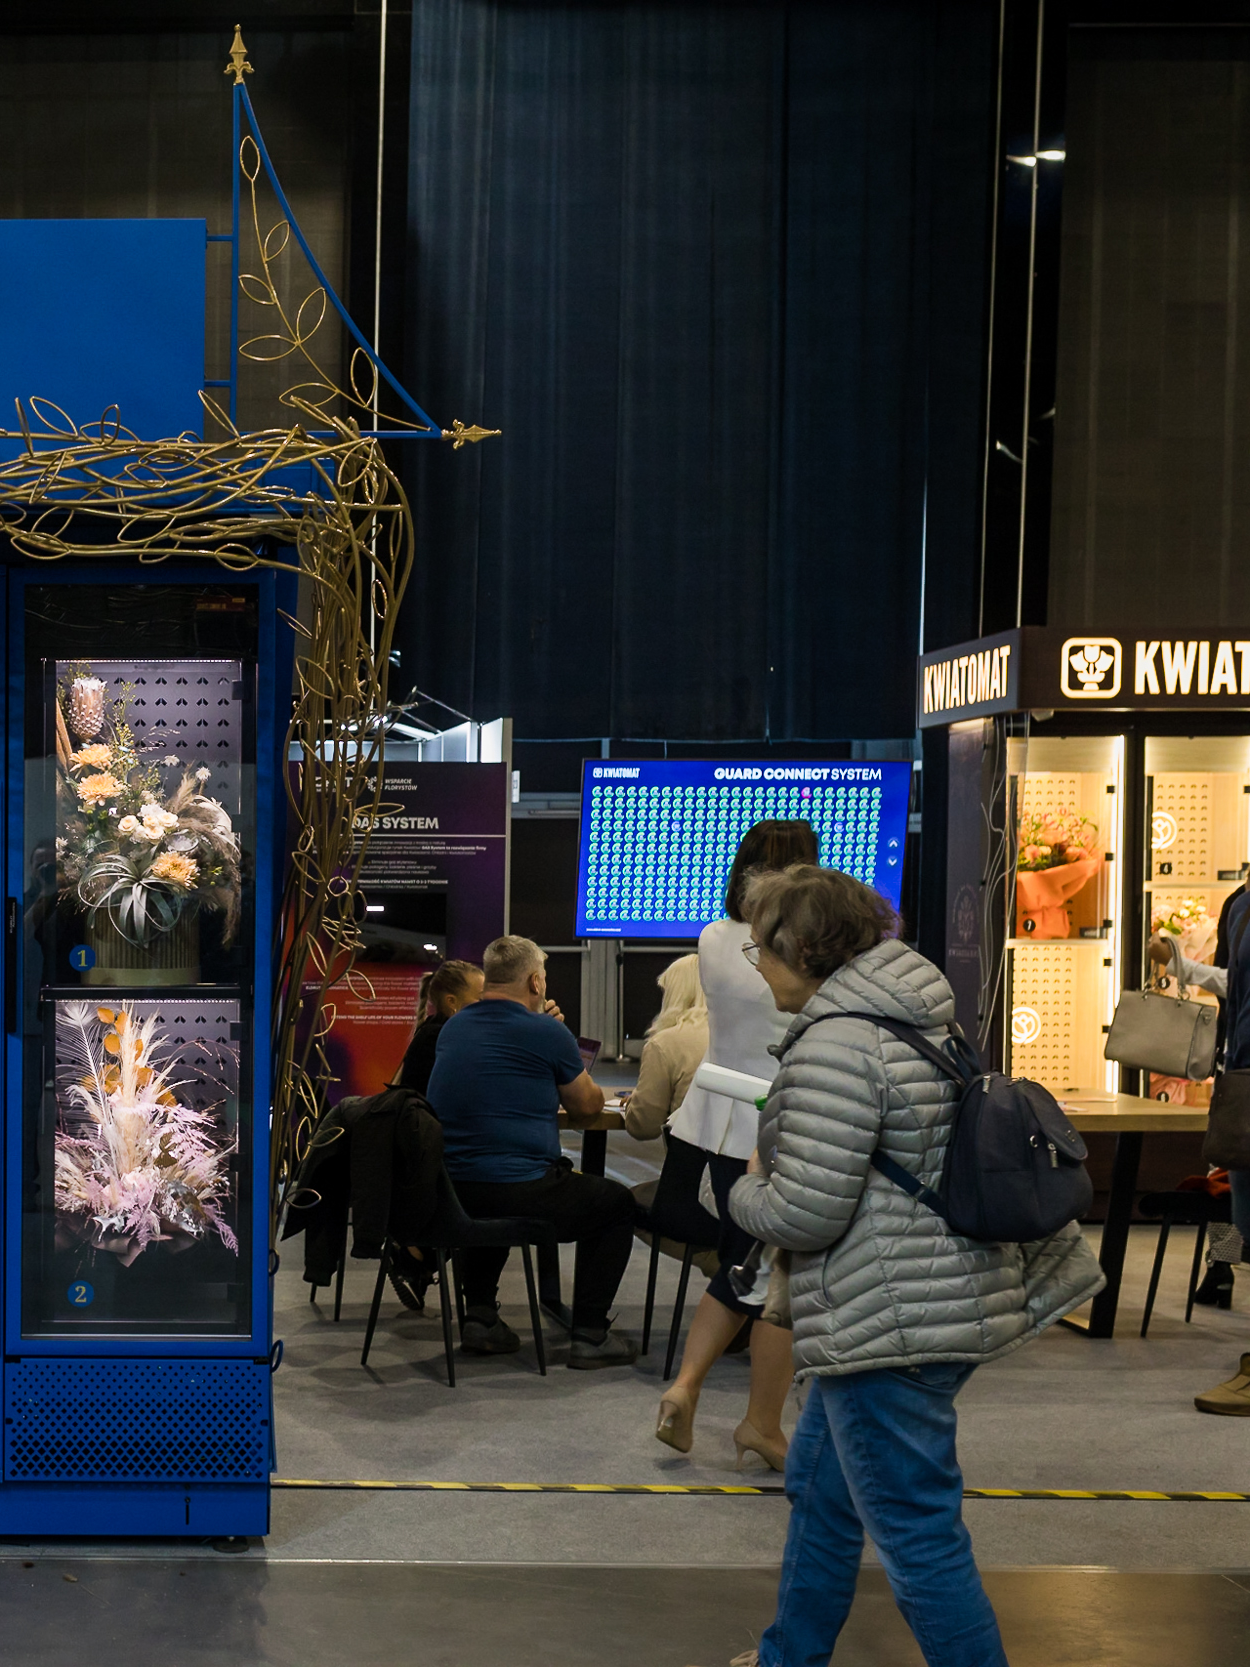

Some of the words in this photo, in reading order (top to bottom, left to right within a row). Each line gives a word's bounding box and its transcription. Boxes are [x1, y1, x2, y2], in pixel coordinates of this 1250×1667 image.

[923, 644, 1012, 715] KWIATOMAT
[603, 767, 641, 779] KWIATOMAT
[714, 768, 762, 780] GUARD
[764, 768, 830, 780] CONNECT
[831, 768, 882, 781] SYSTEM
[352, 817, 380, 830] DAS
[382, 817, 440, 830] SYSTEM
[77, 950, 88, 967] 1
[74, 1285, 87, 1303] 2
